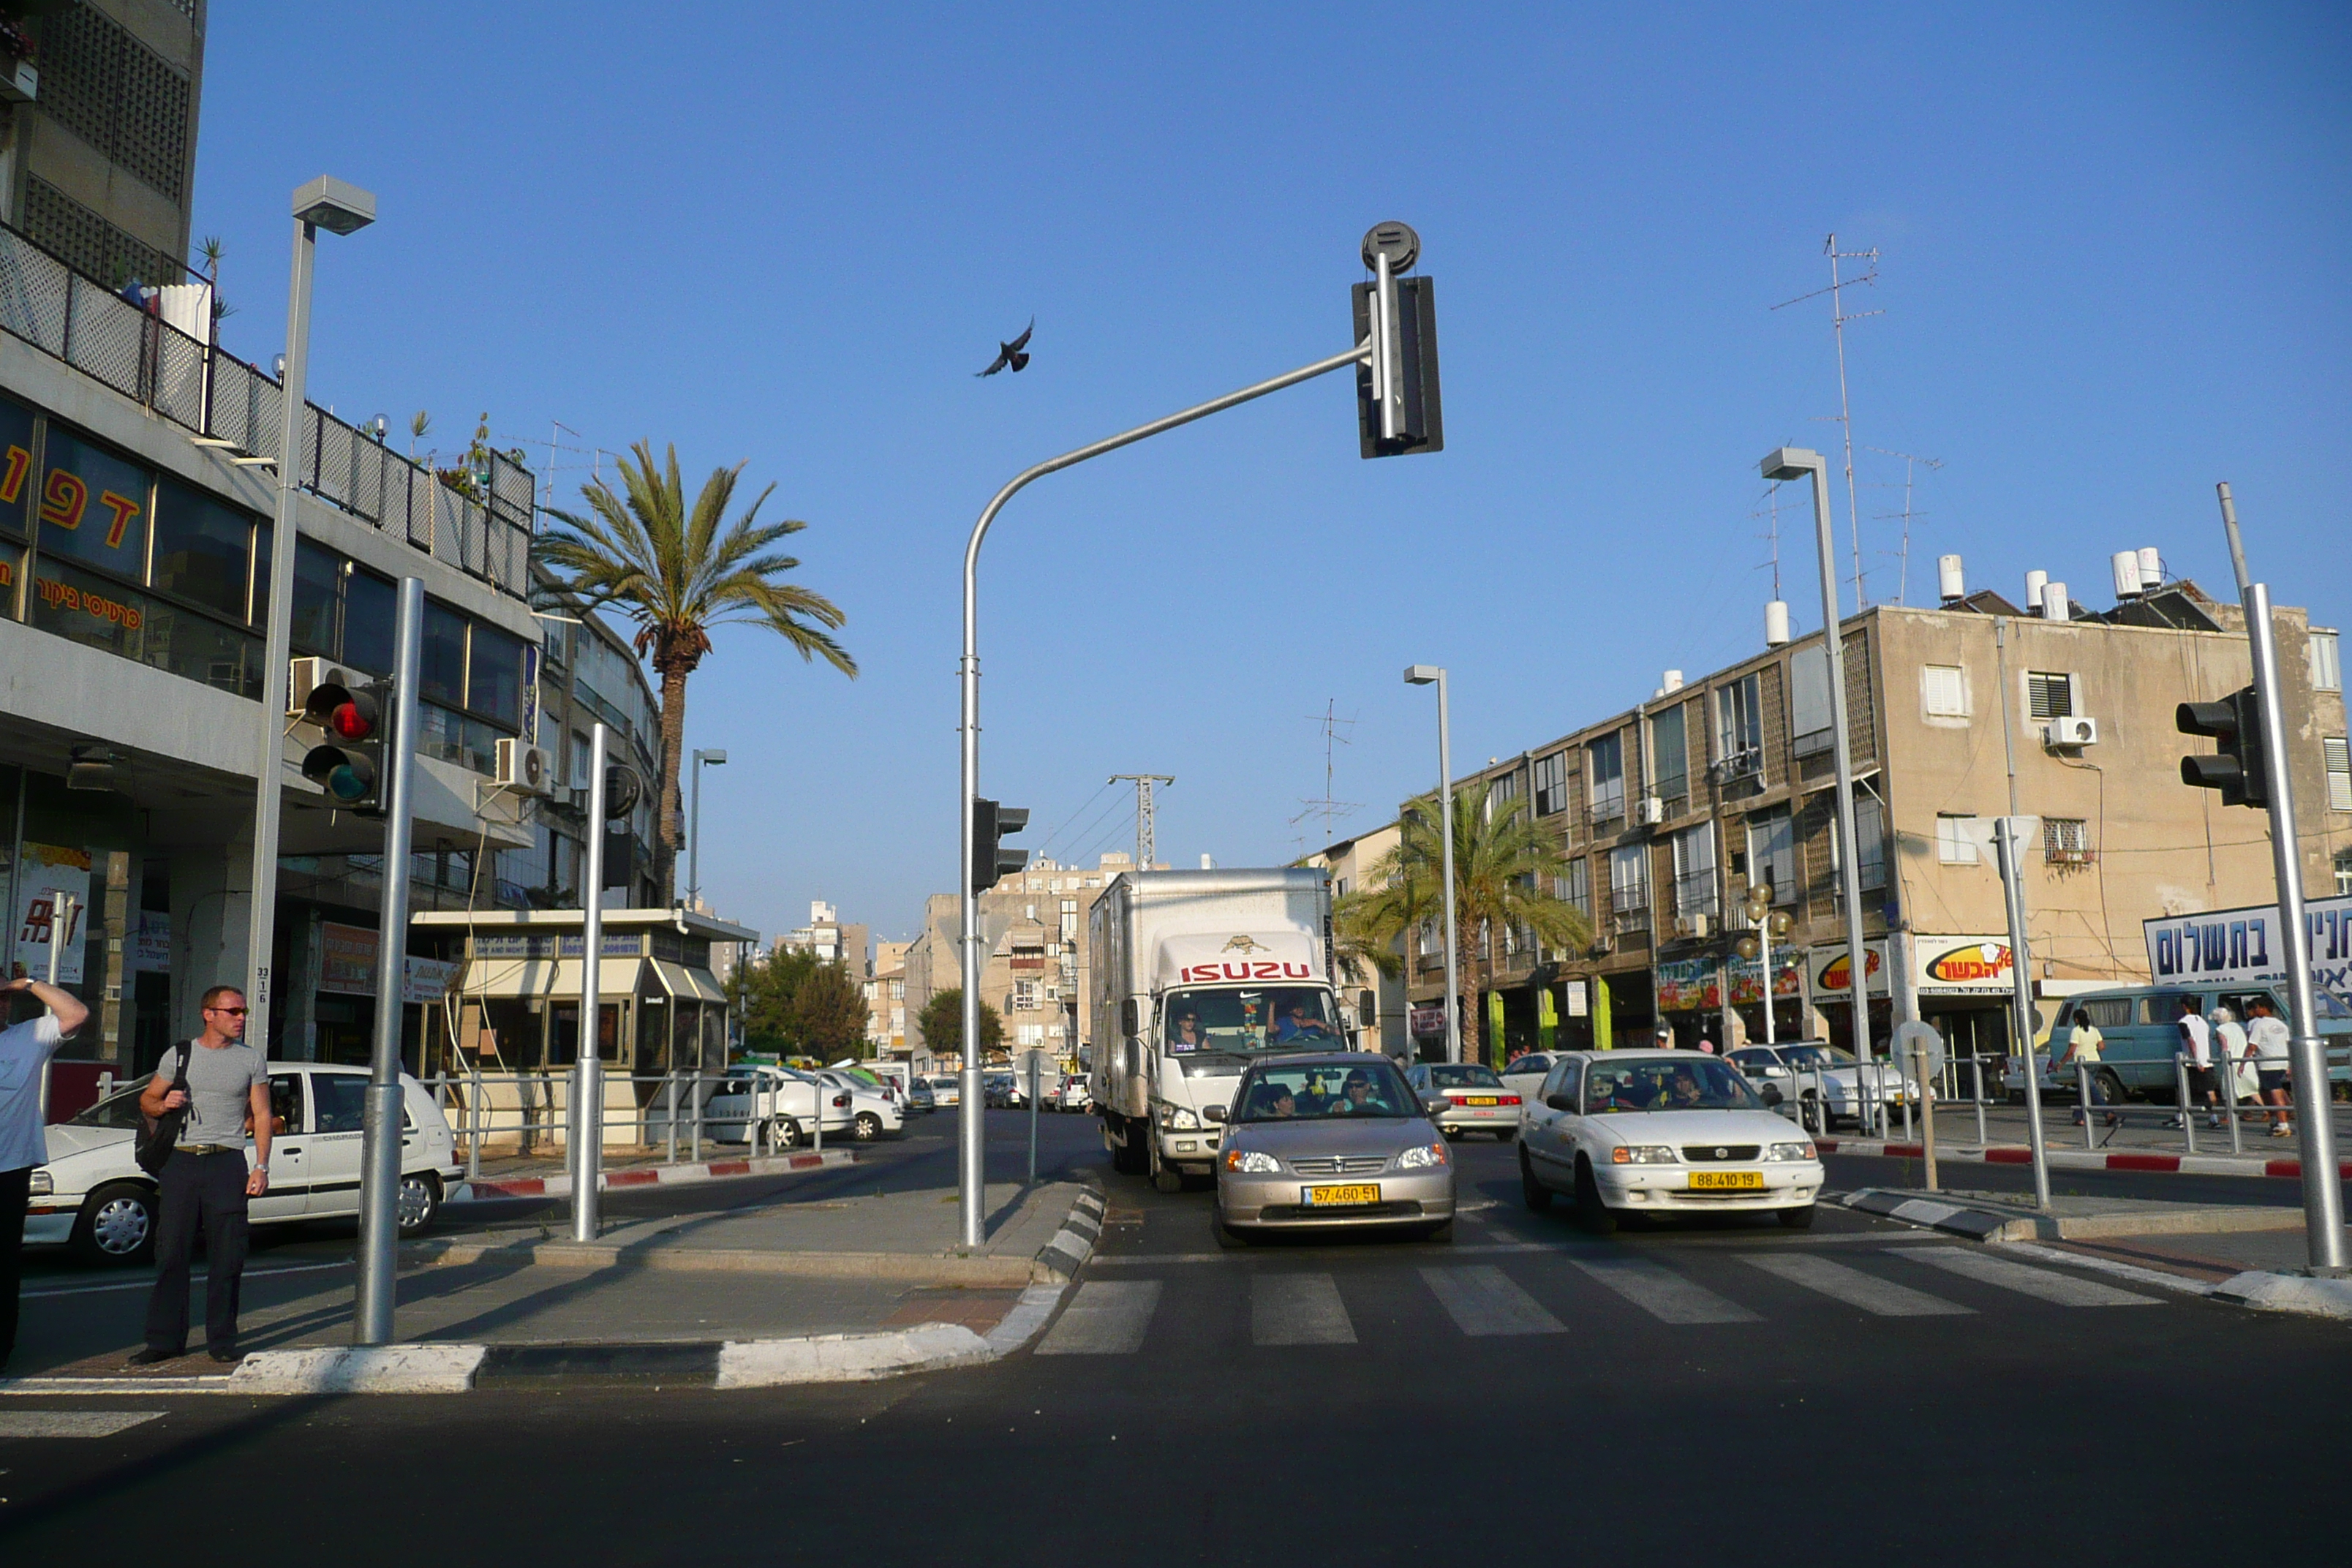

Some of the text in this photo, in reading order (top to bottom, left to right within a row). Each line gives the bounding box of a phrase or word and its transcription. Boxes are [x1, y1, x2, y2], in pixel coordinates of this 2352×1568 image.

[37, 576, 141, 630] כרטיסי ביקור
[2304, 909, 2352, 961] חני
[2157, 919, 2269, 975] בתשלום
[257, 967, 268, 976] 33
[1180, 962, 1311, 983] ISUZU
[1939, 961, 1999, 979] הבשר
[260, 980, 265, 990] 1
[260, 994, 265, 1003] 6
[323, 1133, 363, 1141] CHAMAD
